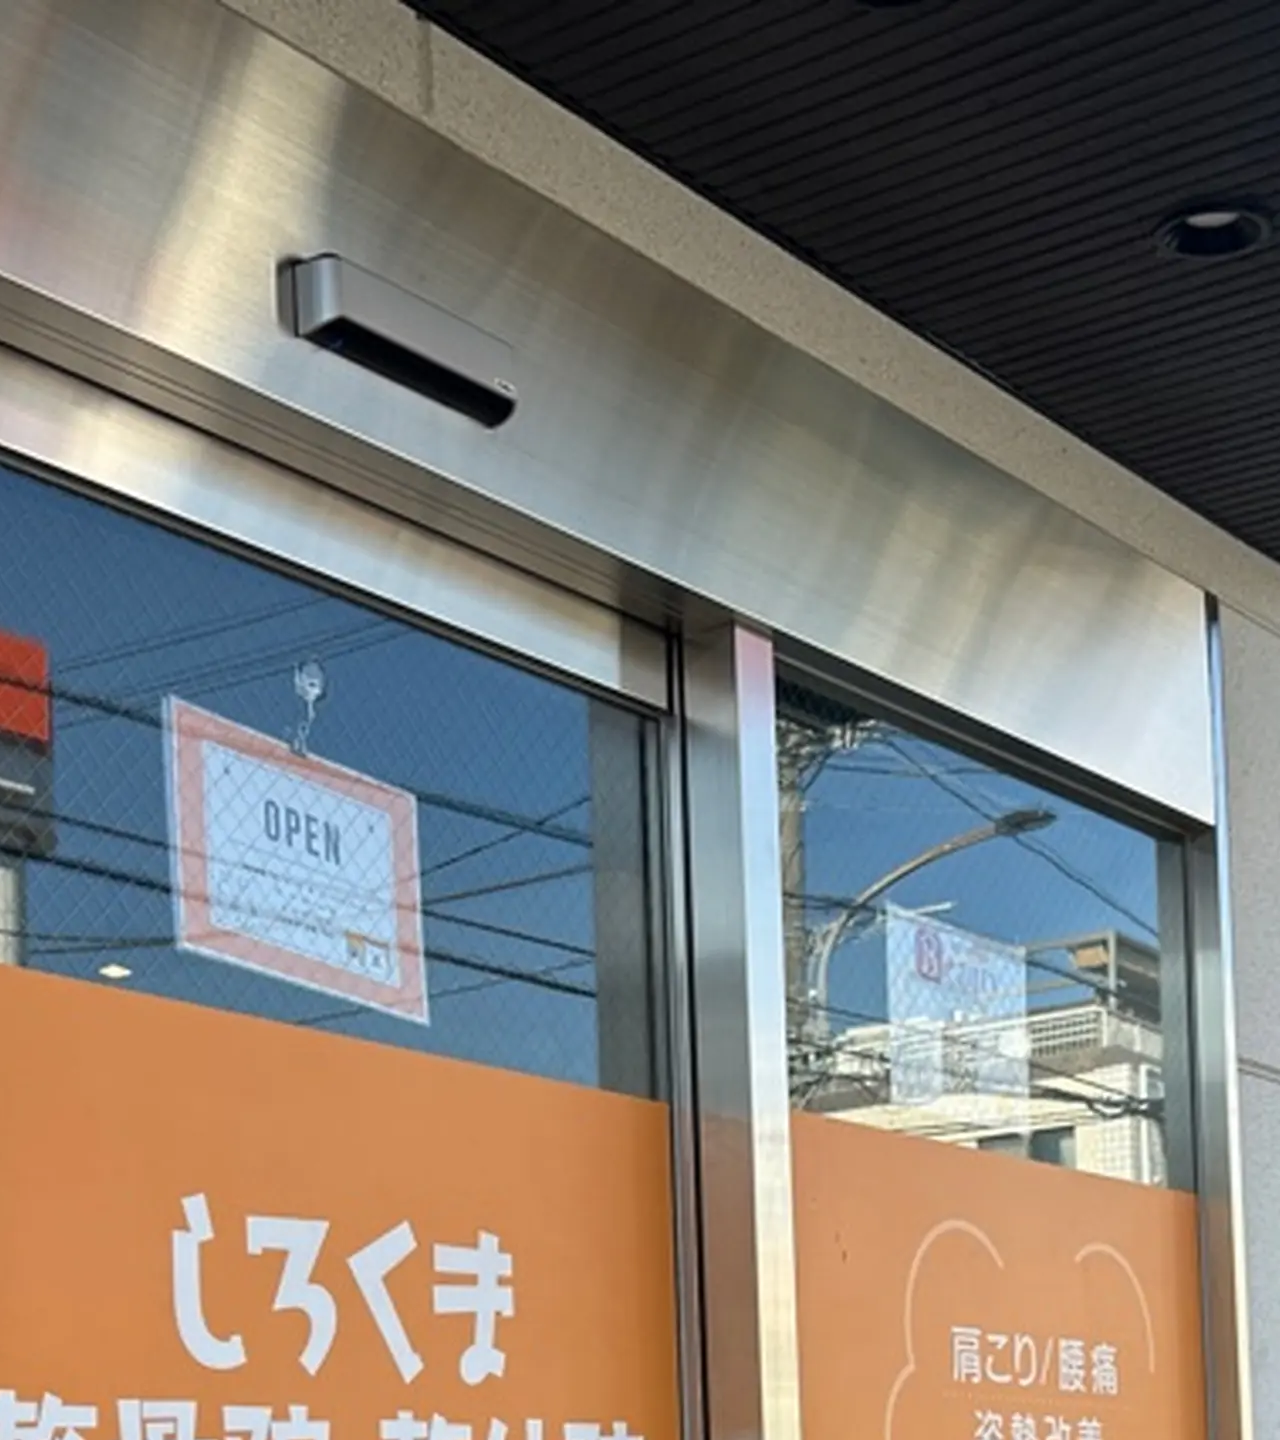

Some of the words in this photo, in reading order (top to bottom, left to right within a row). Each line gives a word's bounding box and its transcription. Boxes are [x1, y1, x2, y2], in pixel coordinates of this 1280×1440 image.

[263, 799, 342, 866] OPEN
[171, 1192, 516, 1386] しろくま
[949, 1325, 1120, 1396] 肩こり/腰痛
